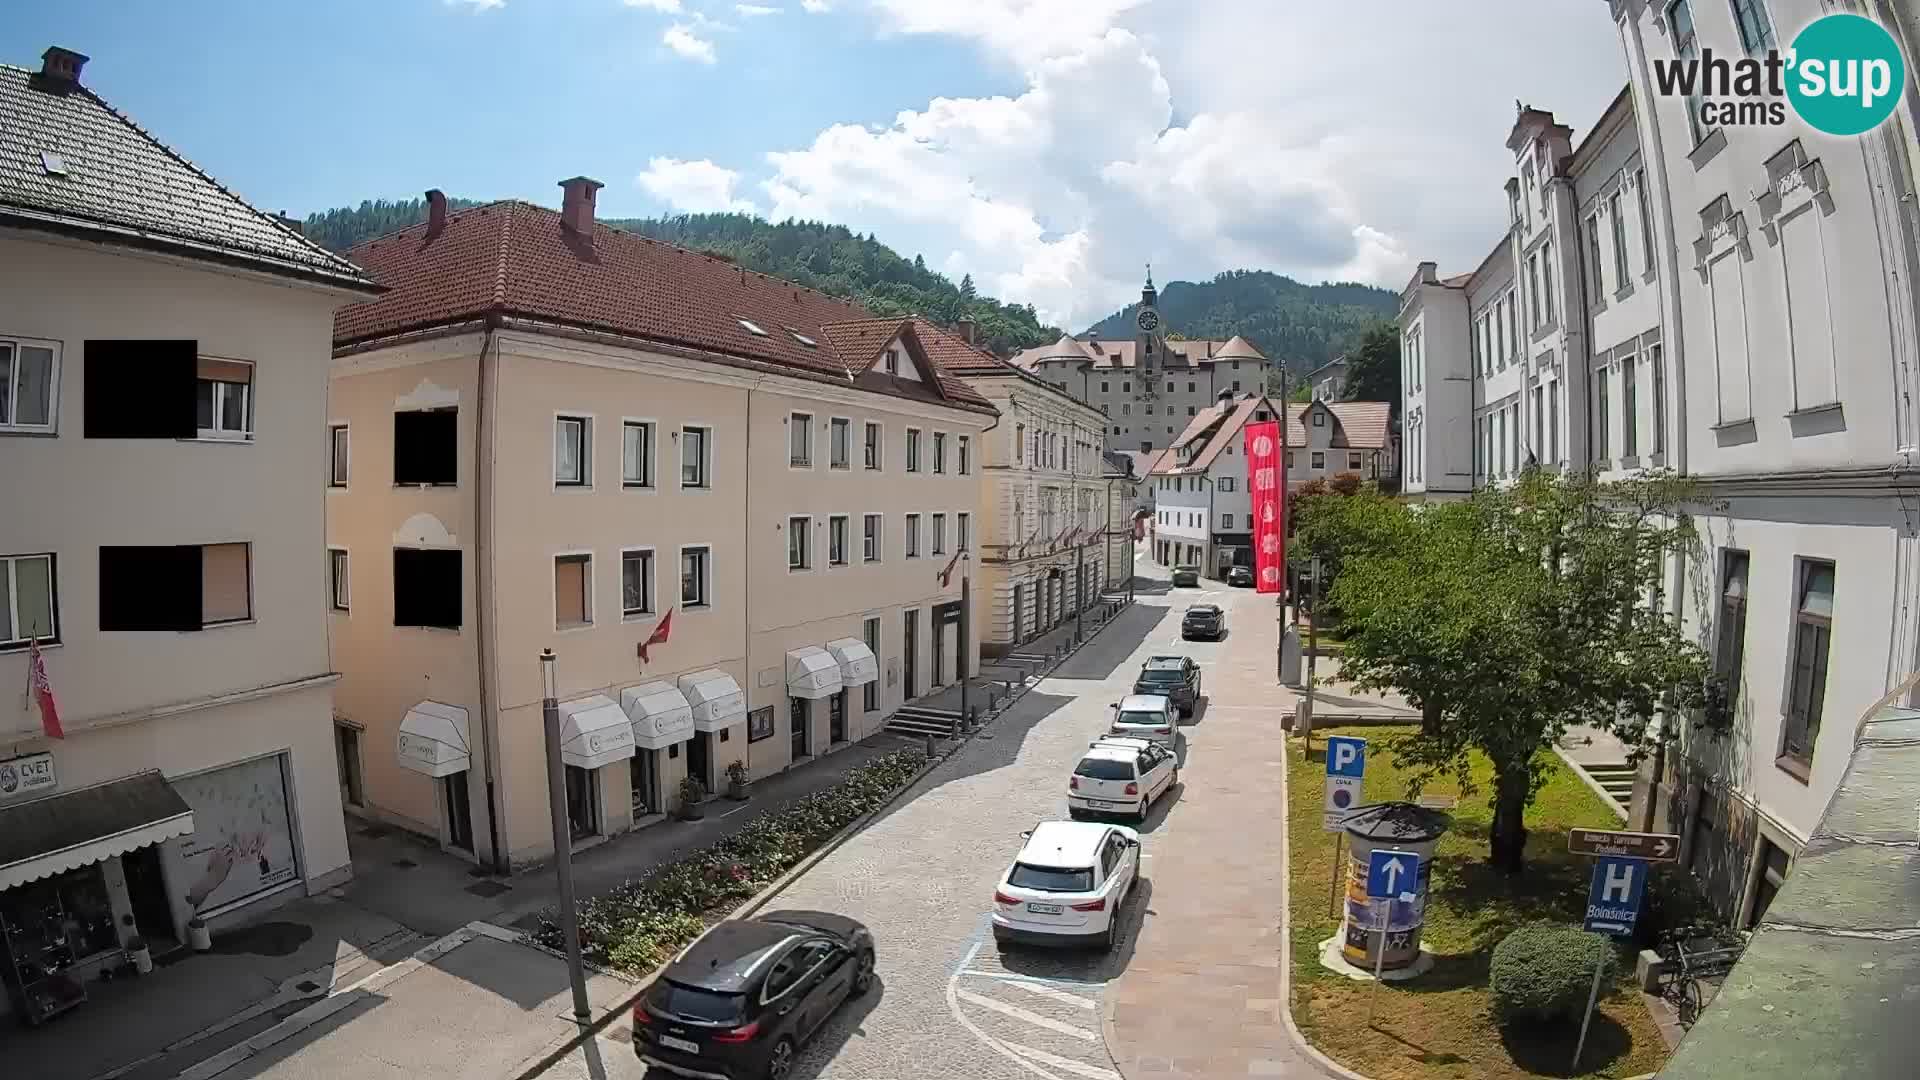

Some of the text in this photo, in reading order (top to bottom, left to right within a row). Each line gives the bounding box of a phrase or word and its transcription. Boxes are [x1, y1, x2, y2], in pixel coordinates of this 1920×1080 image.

[21, 759, 49, 777] CVET
[1335, 743, 1356, 771] P
[1602, 863, 1634, 903] H
